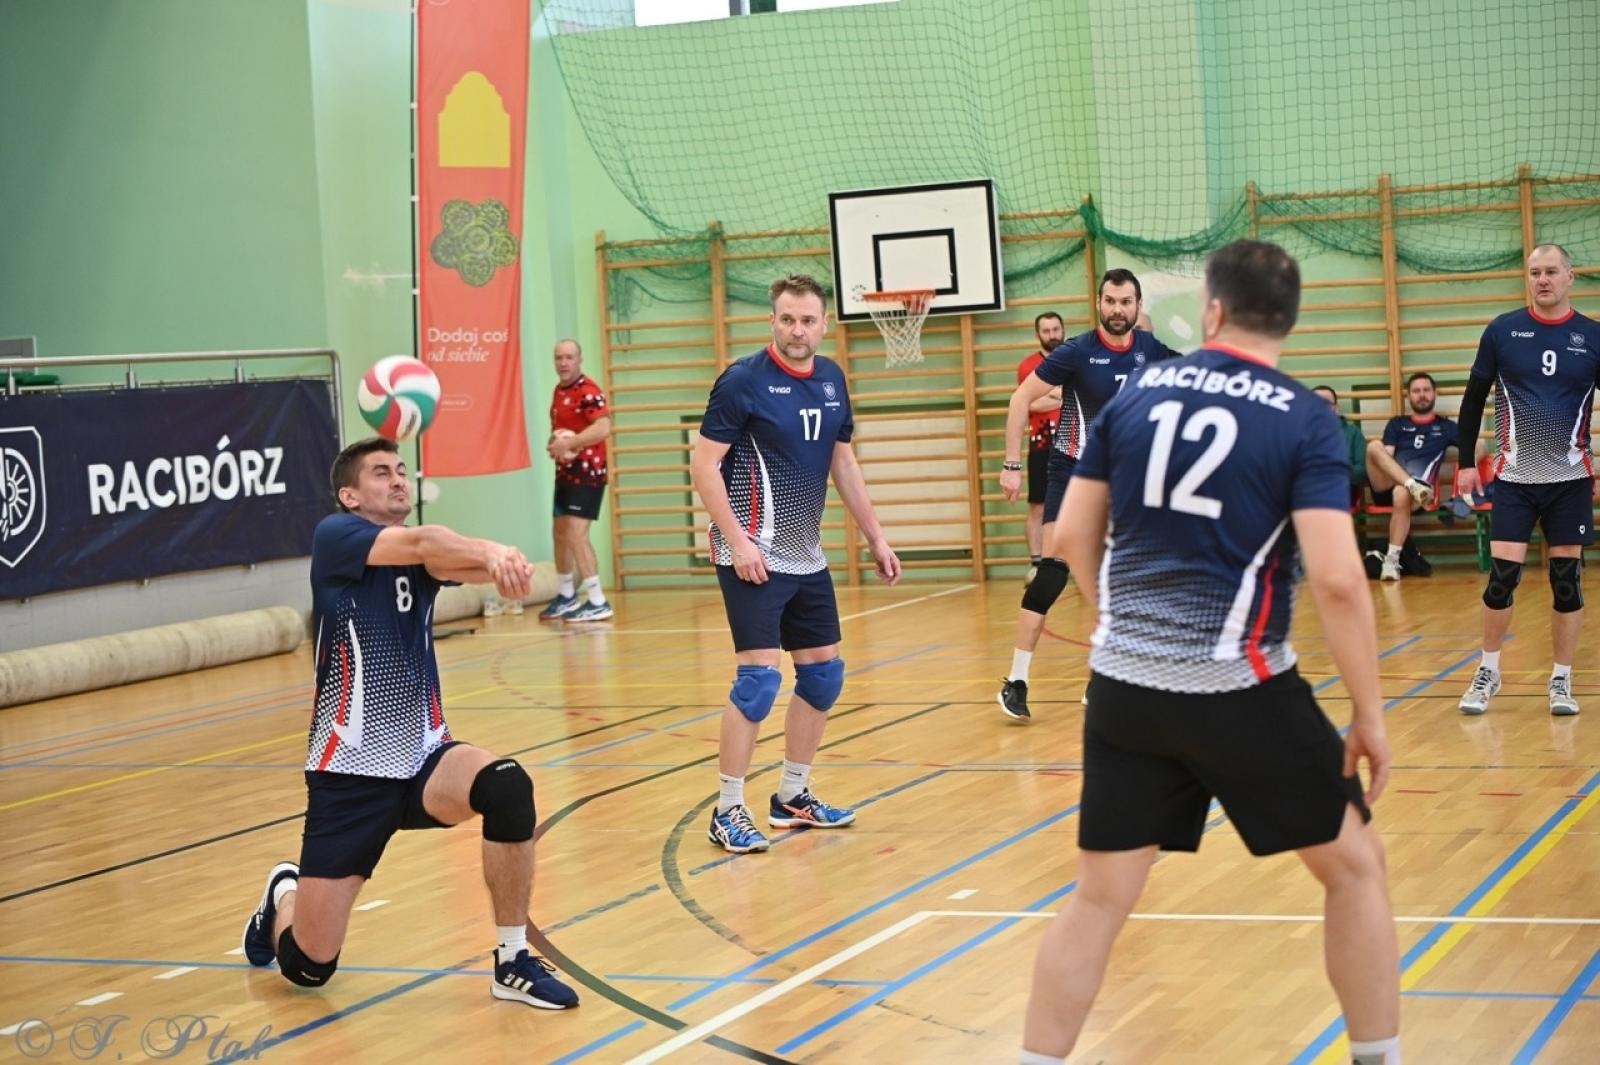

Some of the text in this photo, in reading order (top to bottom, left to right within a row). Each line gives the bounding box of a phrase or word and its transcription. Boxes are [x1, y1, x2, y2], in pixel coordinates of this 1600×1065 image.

[428, 328, 478, 347] Dodaj
[1541, 349, 1557, 376] 9
[1114, 374, 1128, 393] 7
[1137, 365, 1296, 413] RACIBÓRZ
[799, 408, 822, 441] 17
[1413, 434, 1426, 449] 6
[87, 434, 287, 516] RACIBÓRZ
[1143, 399, 1239, 520] 12
[395, 576, 413, 613] 8
